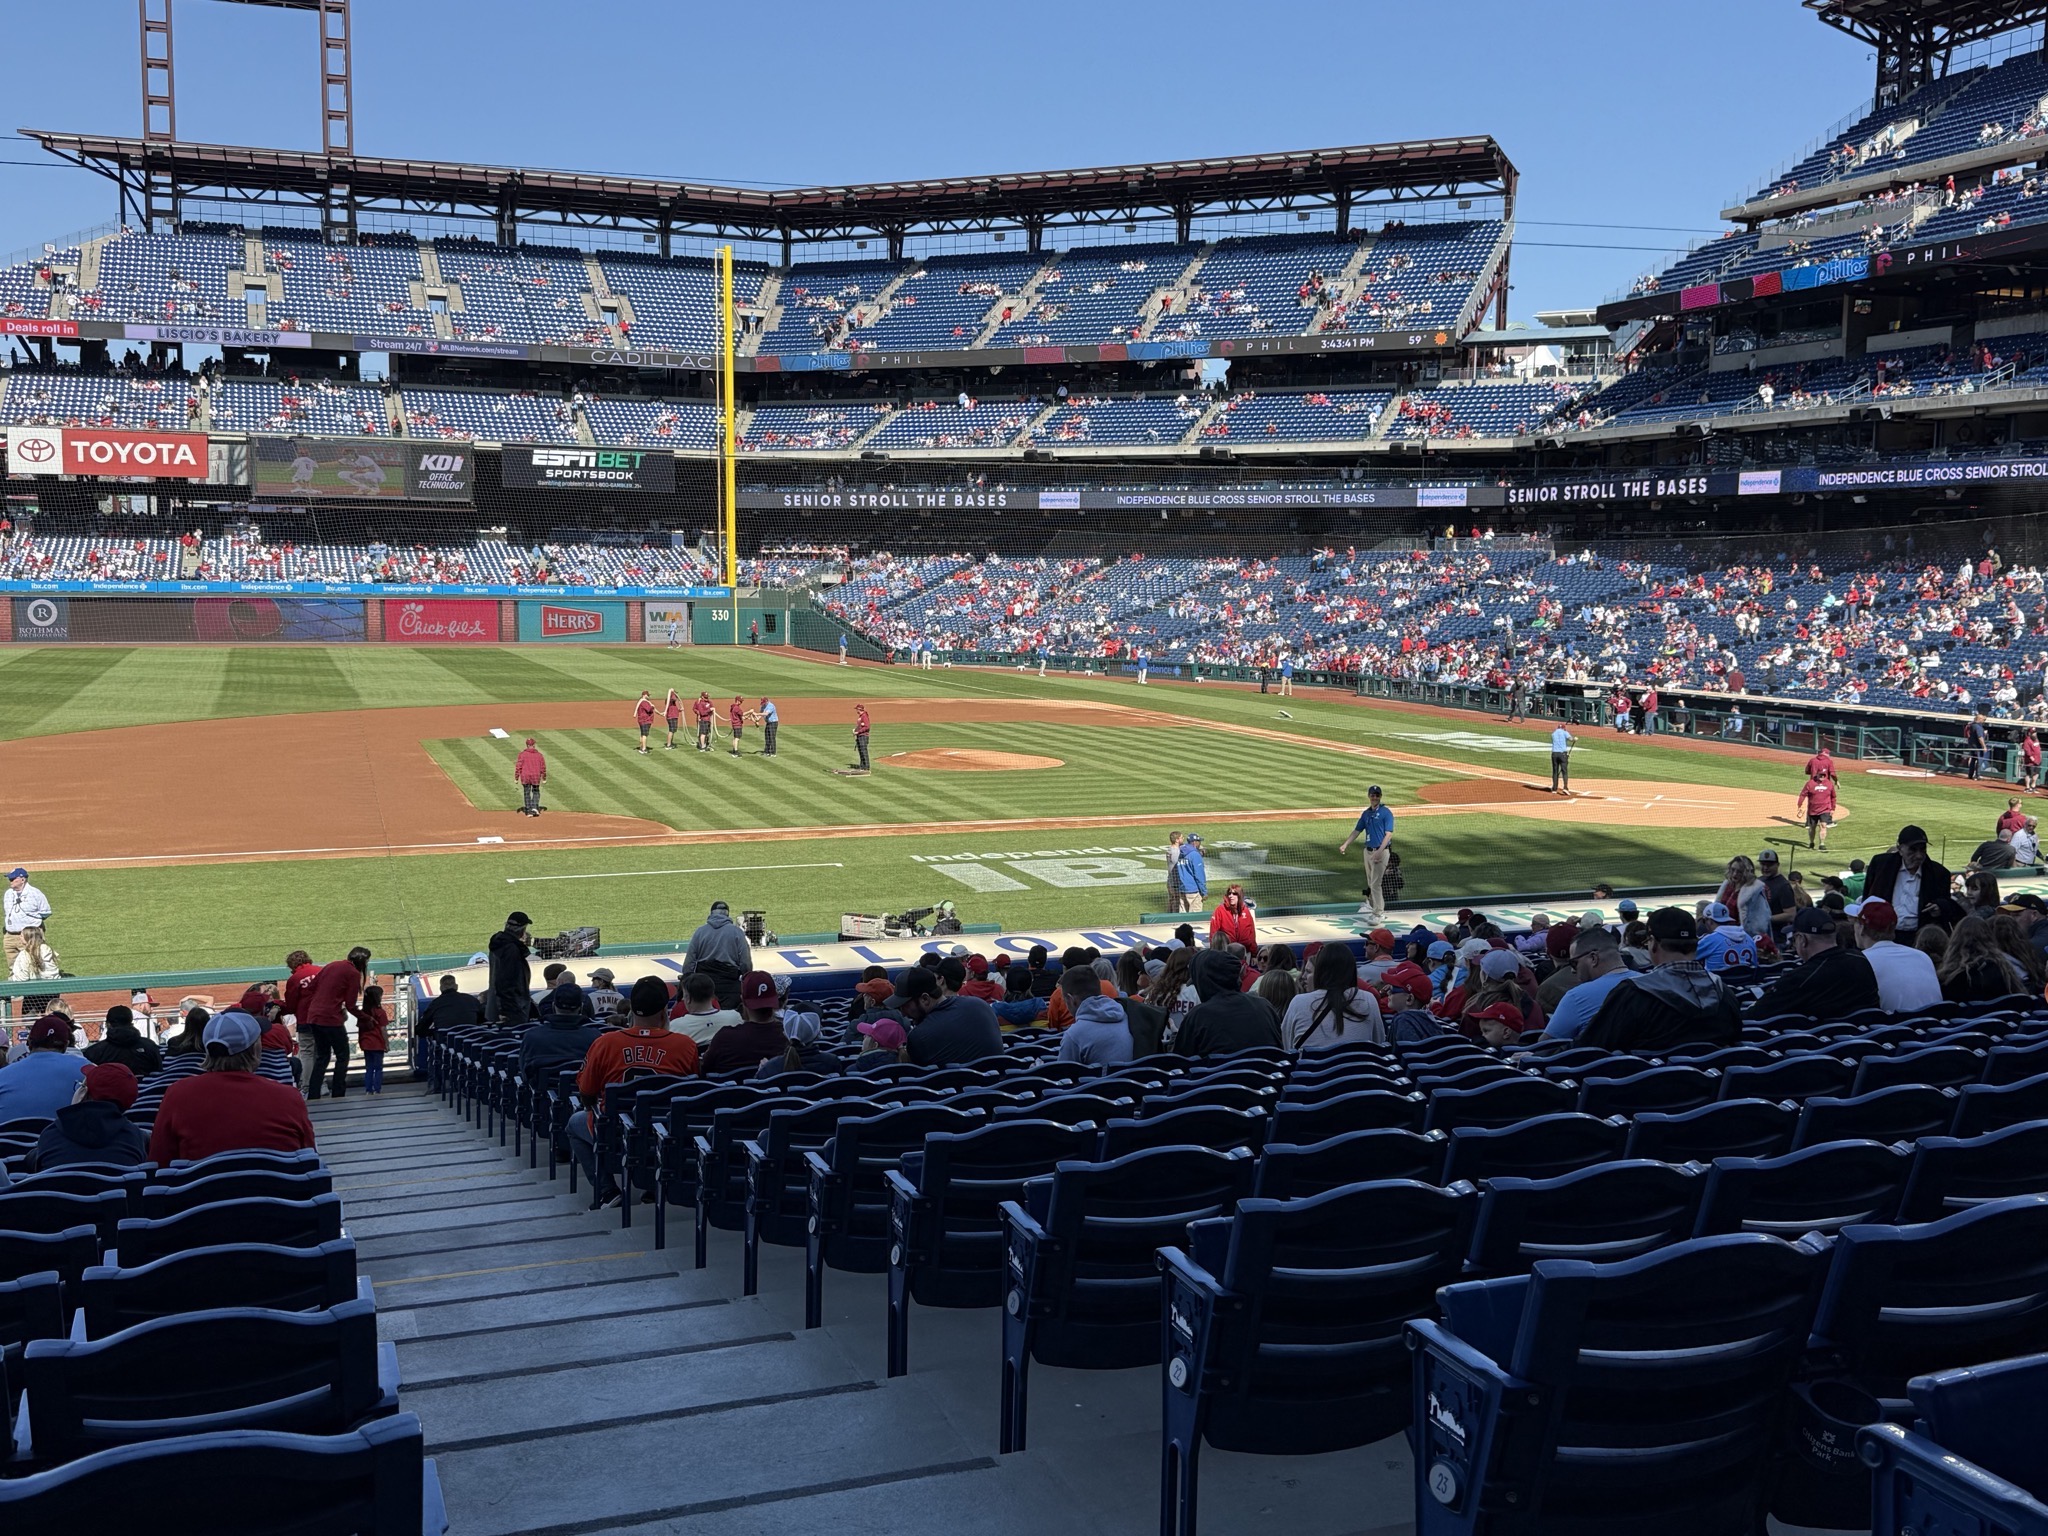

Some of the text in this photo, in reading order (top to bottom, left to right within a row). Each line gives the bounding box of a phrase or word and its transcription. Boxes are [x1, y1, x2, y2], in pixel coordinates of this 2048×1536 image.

[6, 322, 74, 334] Deals roll in
[157, 327, 280, 344] LISCIO'S BAKERY
[370, 339, 422, 350] Stream 24/7
[441, 344, 519, 355] MLBNetwork.com/stream
[1321, 337, 1374, 349] 3:43:41 PM
[591, 350, 711, 368] CADILLAC
[70, 440, 197, 466] TOYOTA
[532, 449, 646, 469] ESPN BET
[429, 473, 454, 481] OFFICE
[546, 469, 633, 480] SPORTSBOOK
[1819, 470, 1894, 486] INDEPENDENCE
[1897, 468, 1923, 482] BLUE
[1924, 466, 1963, 481] CROSS
[1965, 464, 2007, 479] SENIOR
[418, 481, 465, 489] TECHNOLOGY
[1508, 477, 1707, 503] SENIOR STROLL THE BASES
[784, 494, 1007, 506] SENIOR STROLL THE BASES
[1117, 493, 1375, 505] INDEPENDENCE BLUE CROSS SENIOR STROLL THE BASES
[37, 608, 48, 617] R
[649, 611, 683, 622] WM
[711, 609, 729, 621] 330
[399, 608, 486, 638] Chick-fil-A
[547, 612, 596, 630] HERR'S
[622, 1045, 667, 1066] BELT
[1173, 1364, 1182, 1381] 22
[1802, 1427, 1855, 1458] Citizens Bank
[1811, 1446, 1832, 1461] Park
[1436, 1472, 1448, 1495] 23
